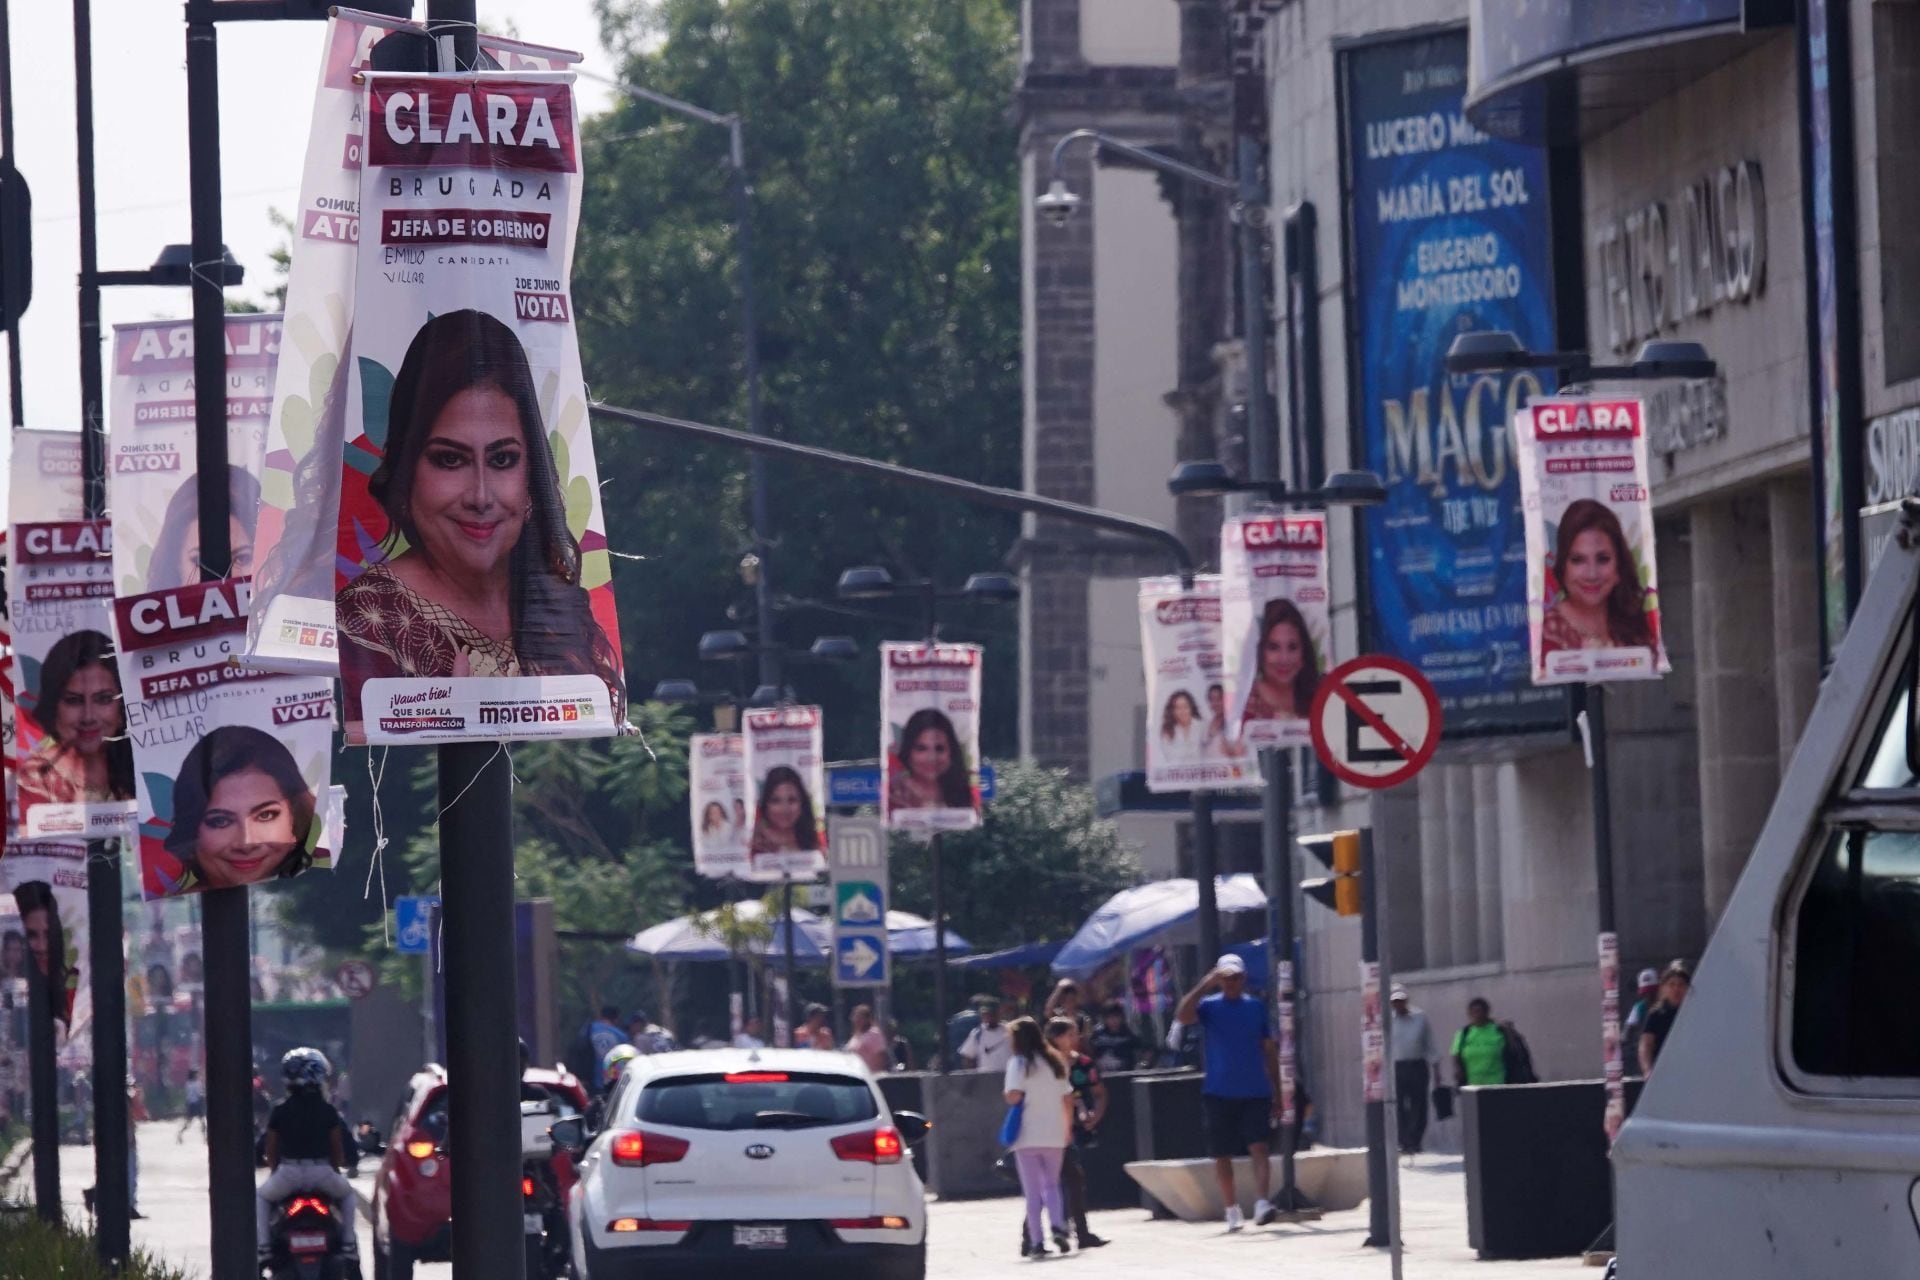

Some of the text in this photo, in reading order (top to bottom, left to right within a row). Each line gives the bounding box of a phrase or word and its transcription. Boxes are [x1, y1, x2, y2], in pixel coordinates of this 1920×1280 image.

[385, 92, 560, 149] CLARA
[1366, 112, 1446, 158] LUCERO
[390, 177, 551, 200] BRUGADA
[1377, 167, 1529, 223] MARÍA DEL SOL
[390, 219, 433, 237] JEFA
[437, 218, 466, 236] DE
[1416, 233, 1498, 274] EUGENIO
[383, 271, 425, 285] VILLAR
[515, 277, 560, 291] 2 DE JUNIO
[1396, 264, 1522, 311] MONTESSORO
[517, 294, 566, 319] VOTA
[1538, 406, 1633, 434] CLARA
[1382, 371, 1545, 498] MAGO
[1613, 489, 1645, 501] VOTA
[1246, 523, 1319, 545] CLARA
[29, 567, 111, 577] BRUGA
[30, 586, 62, 598] JEFA
[65, 585, 83, 597] DE
[142, 640, 231, 669] BRUG
[149, 675, 192, 695] JEFA
[197, 669, 219, 686] DE
[126, 690, 208, 727] EMILIO
[275, 689, 333, 705] 2 DE JUNIO
[390, 686, 452, 710] ¡Vamos bien!
[276, 701, 333, 723] VOTA
[381, 717, 464, 730] TRANSFORMACIÓN
[393, 707, 452, 717] QUE SIGA LA
[479, 705, 576, 725] morena PT
[1344, 680, 1409, 763] E
[132, 716, 207, 749] VILLAR
